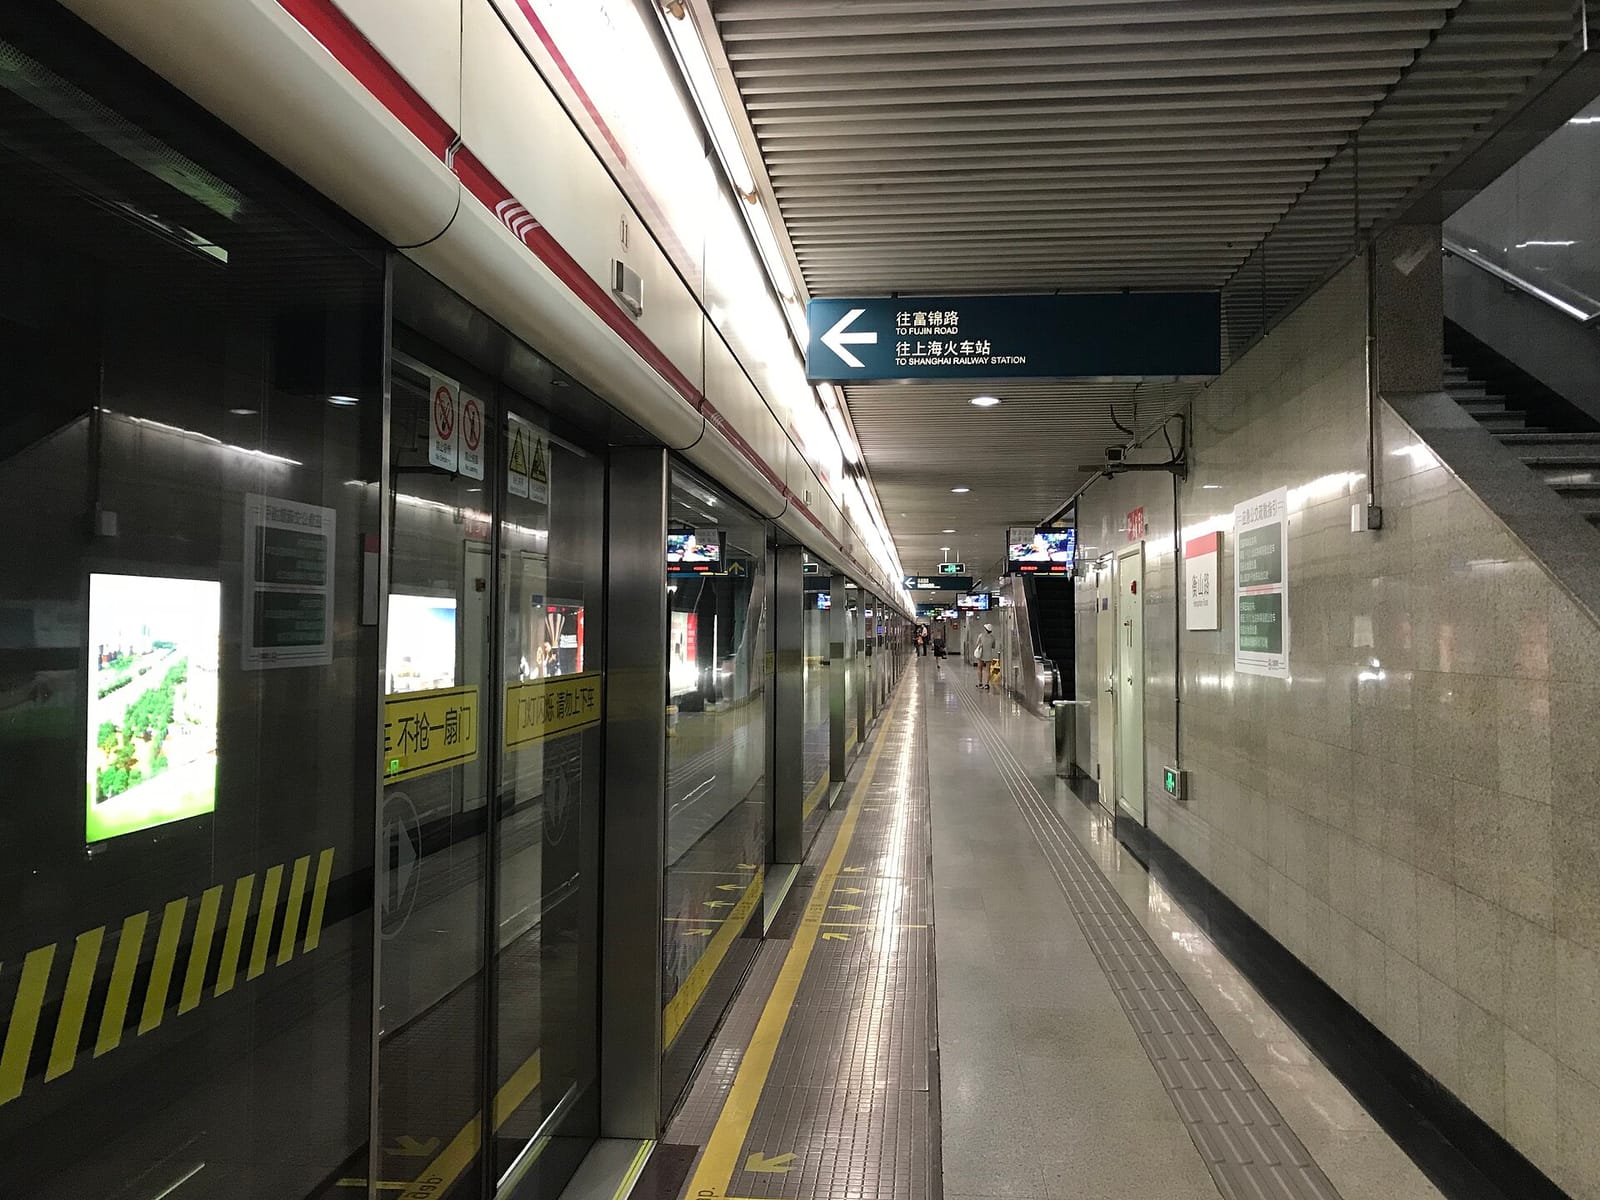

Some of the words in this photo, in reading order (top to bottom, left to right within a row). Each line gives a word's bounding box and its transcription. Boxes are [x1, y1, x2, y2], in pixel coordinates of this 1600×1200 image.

[896, 310, 959, 326] 往富锦路
[895, 327, 907, 335] TO
[908, 327, 932, 335] FUJIN
[934, 326, 958, 335] ROAD
[896, 340, 991, 357] 往上海火车站
[895, 357, 907, 366] TO
[908, 357, 952, 366] SHANGHAI
[953, 356, 989, 365] RAILWAY
[990, 355, 1026, 365] STATION
[397, 706, 471, 756] 不抢一扇门
